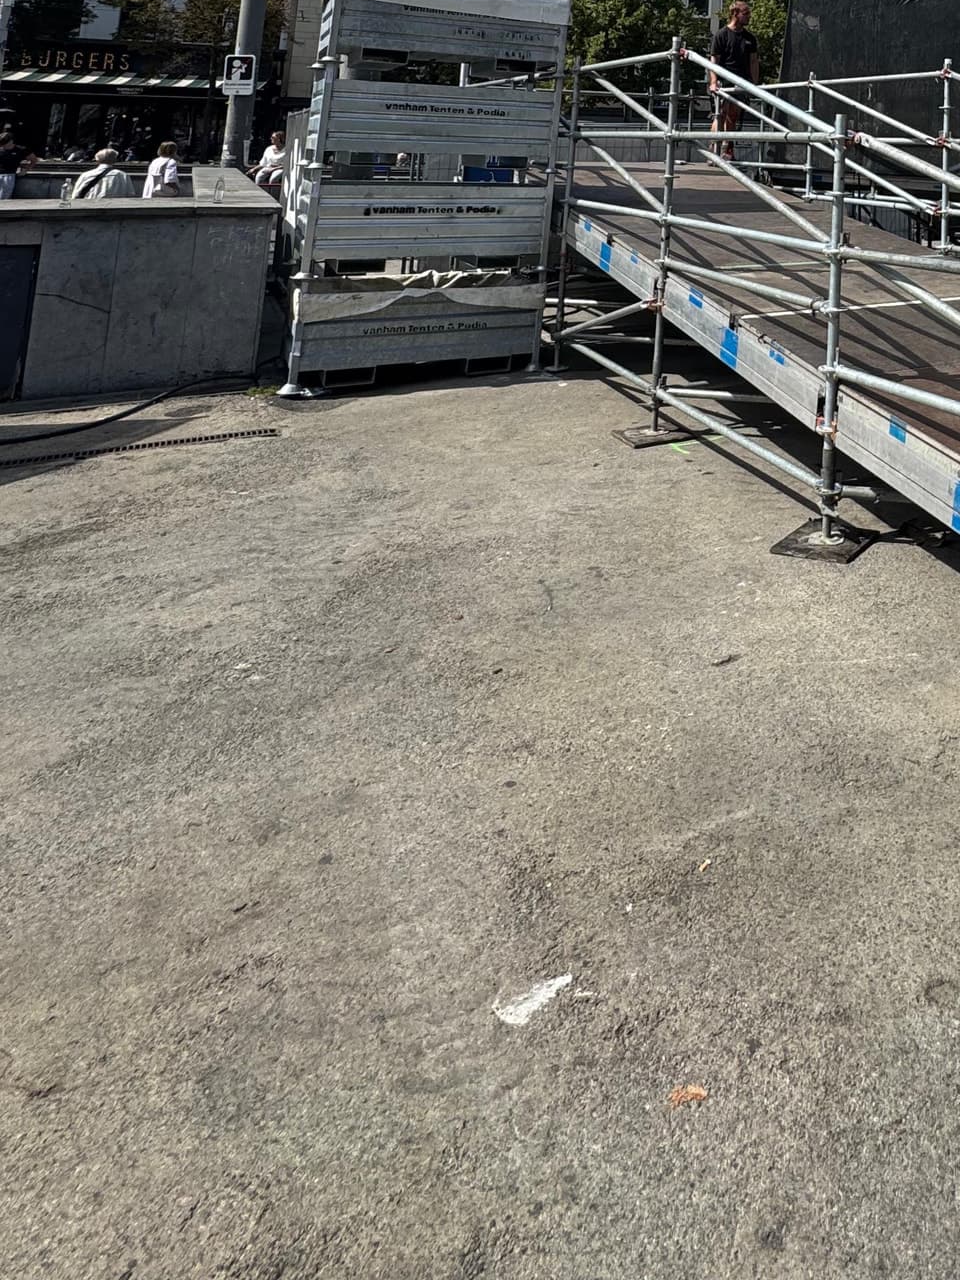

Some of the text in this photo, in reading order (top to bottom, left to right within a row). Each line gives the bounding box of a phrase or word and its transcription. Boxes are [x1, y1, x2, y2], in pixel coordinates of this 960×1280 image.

[385, 102, 506, 117] vanham Tenten & Podia
[372, 205, 496, 214] vanham Tenten & Podia
[363, 326, 406, 335] vanham
[408, 325, 445, 333] Tenten
